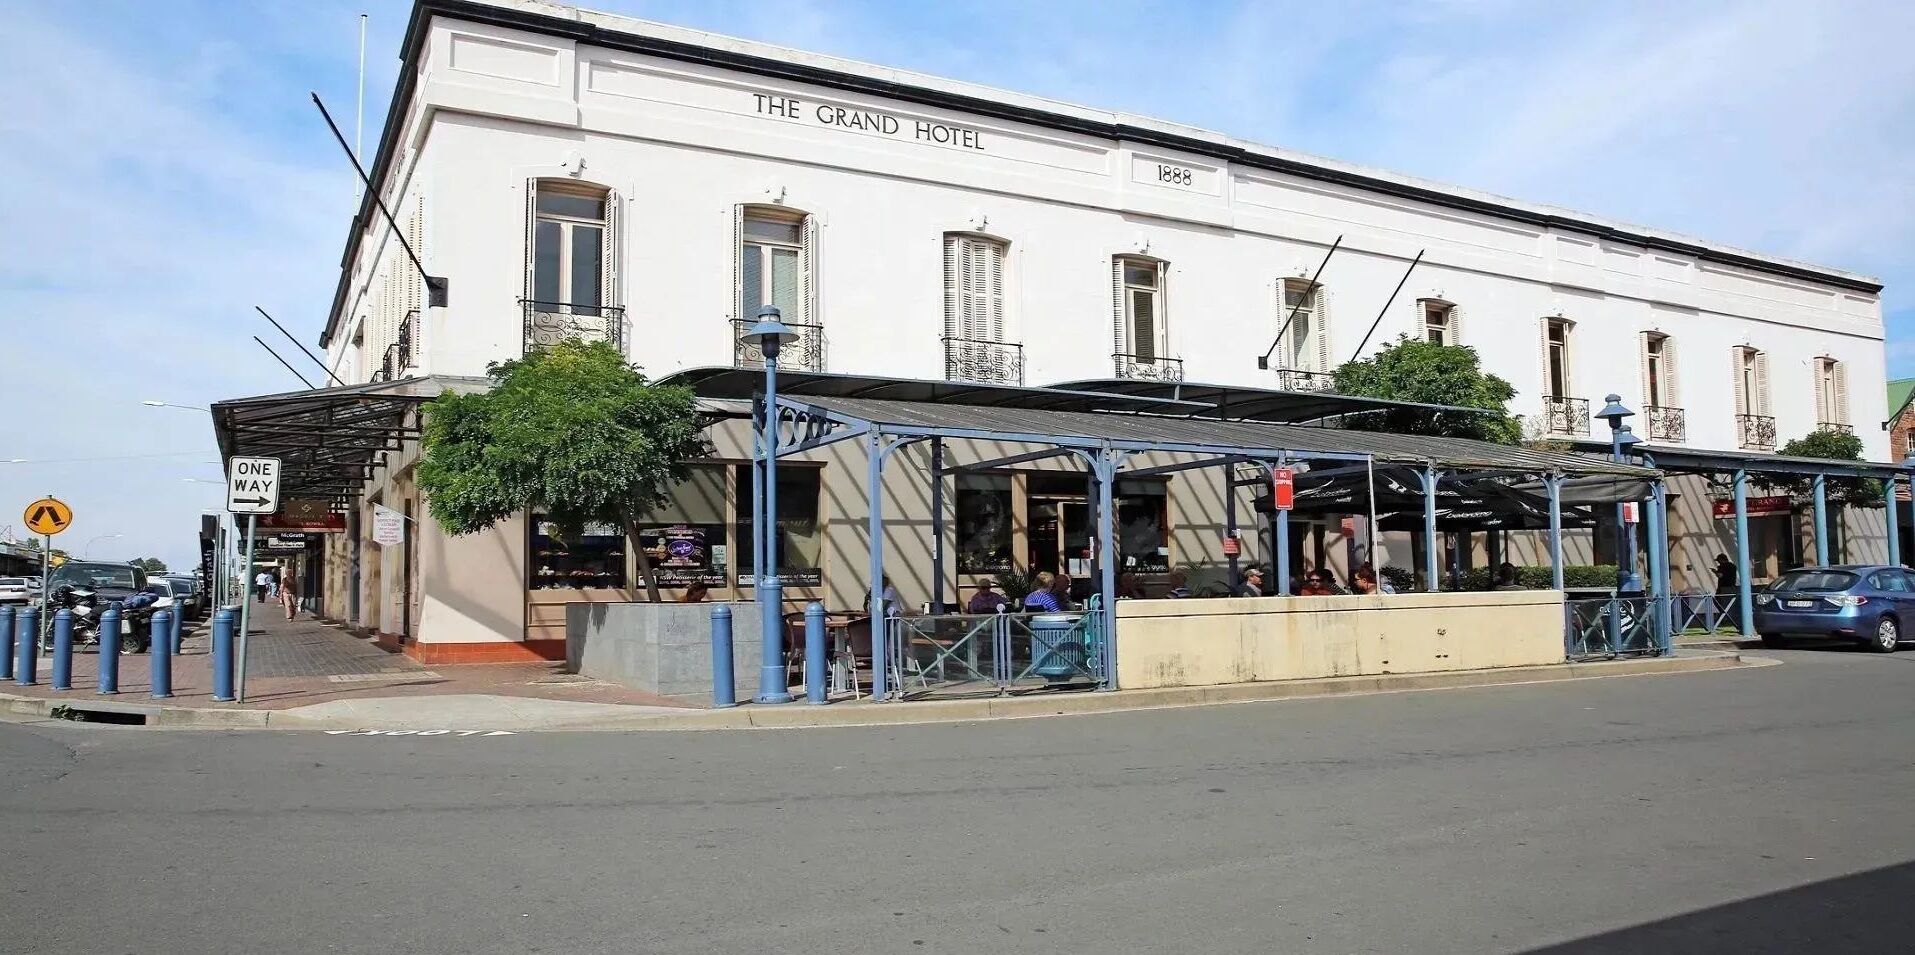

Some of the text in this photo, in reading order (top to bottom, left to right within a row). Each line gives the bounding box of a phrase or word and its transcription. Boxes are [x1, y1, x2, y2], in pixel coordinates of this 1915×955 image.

[753, 93, 985, 150] THE GRAND HOTEL
[1158, 164, 1192, 186] 1888
[238, 462, 272, 475] ONE
[234, 479, 273, 493] WAY
